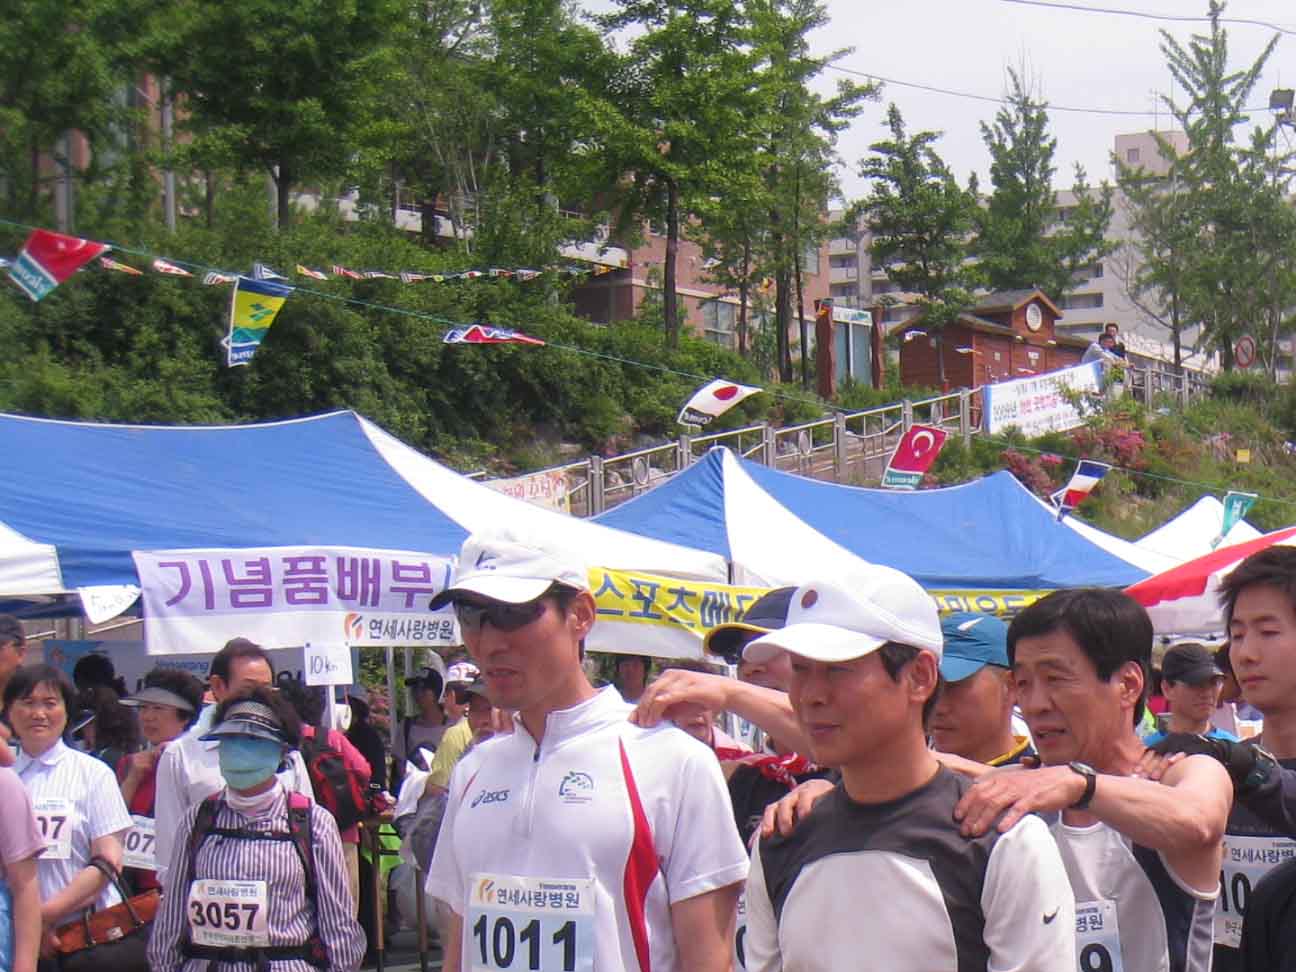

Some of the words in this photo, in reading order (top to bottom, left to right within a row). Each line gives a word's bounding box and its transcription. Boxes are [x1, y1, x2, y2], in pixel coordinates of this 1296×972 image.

[158, 556, 434, 609] 기념품배부
[368, 617, 455, 641] 연세사랑병원
[496, 887, 580, 909] 연세사랑병원
[190, 900, 261, 931] 3057
[473, 914, 577, 972] 1011
